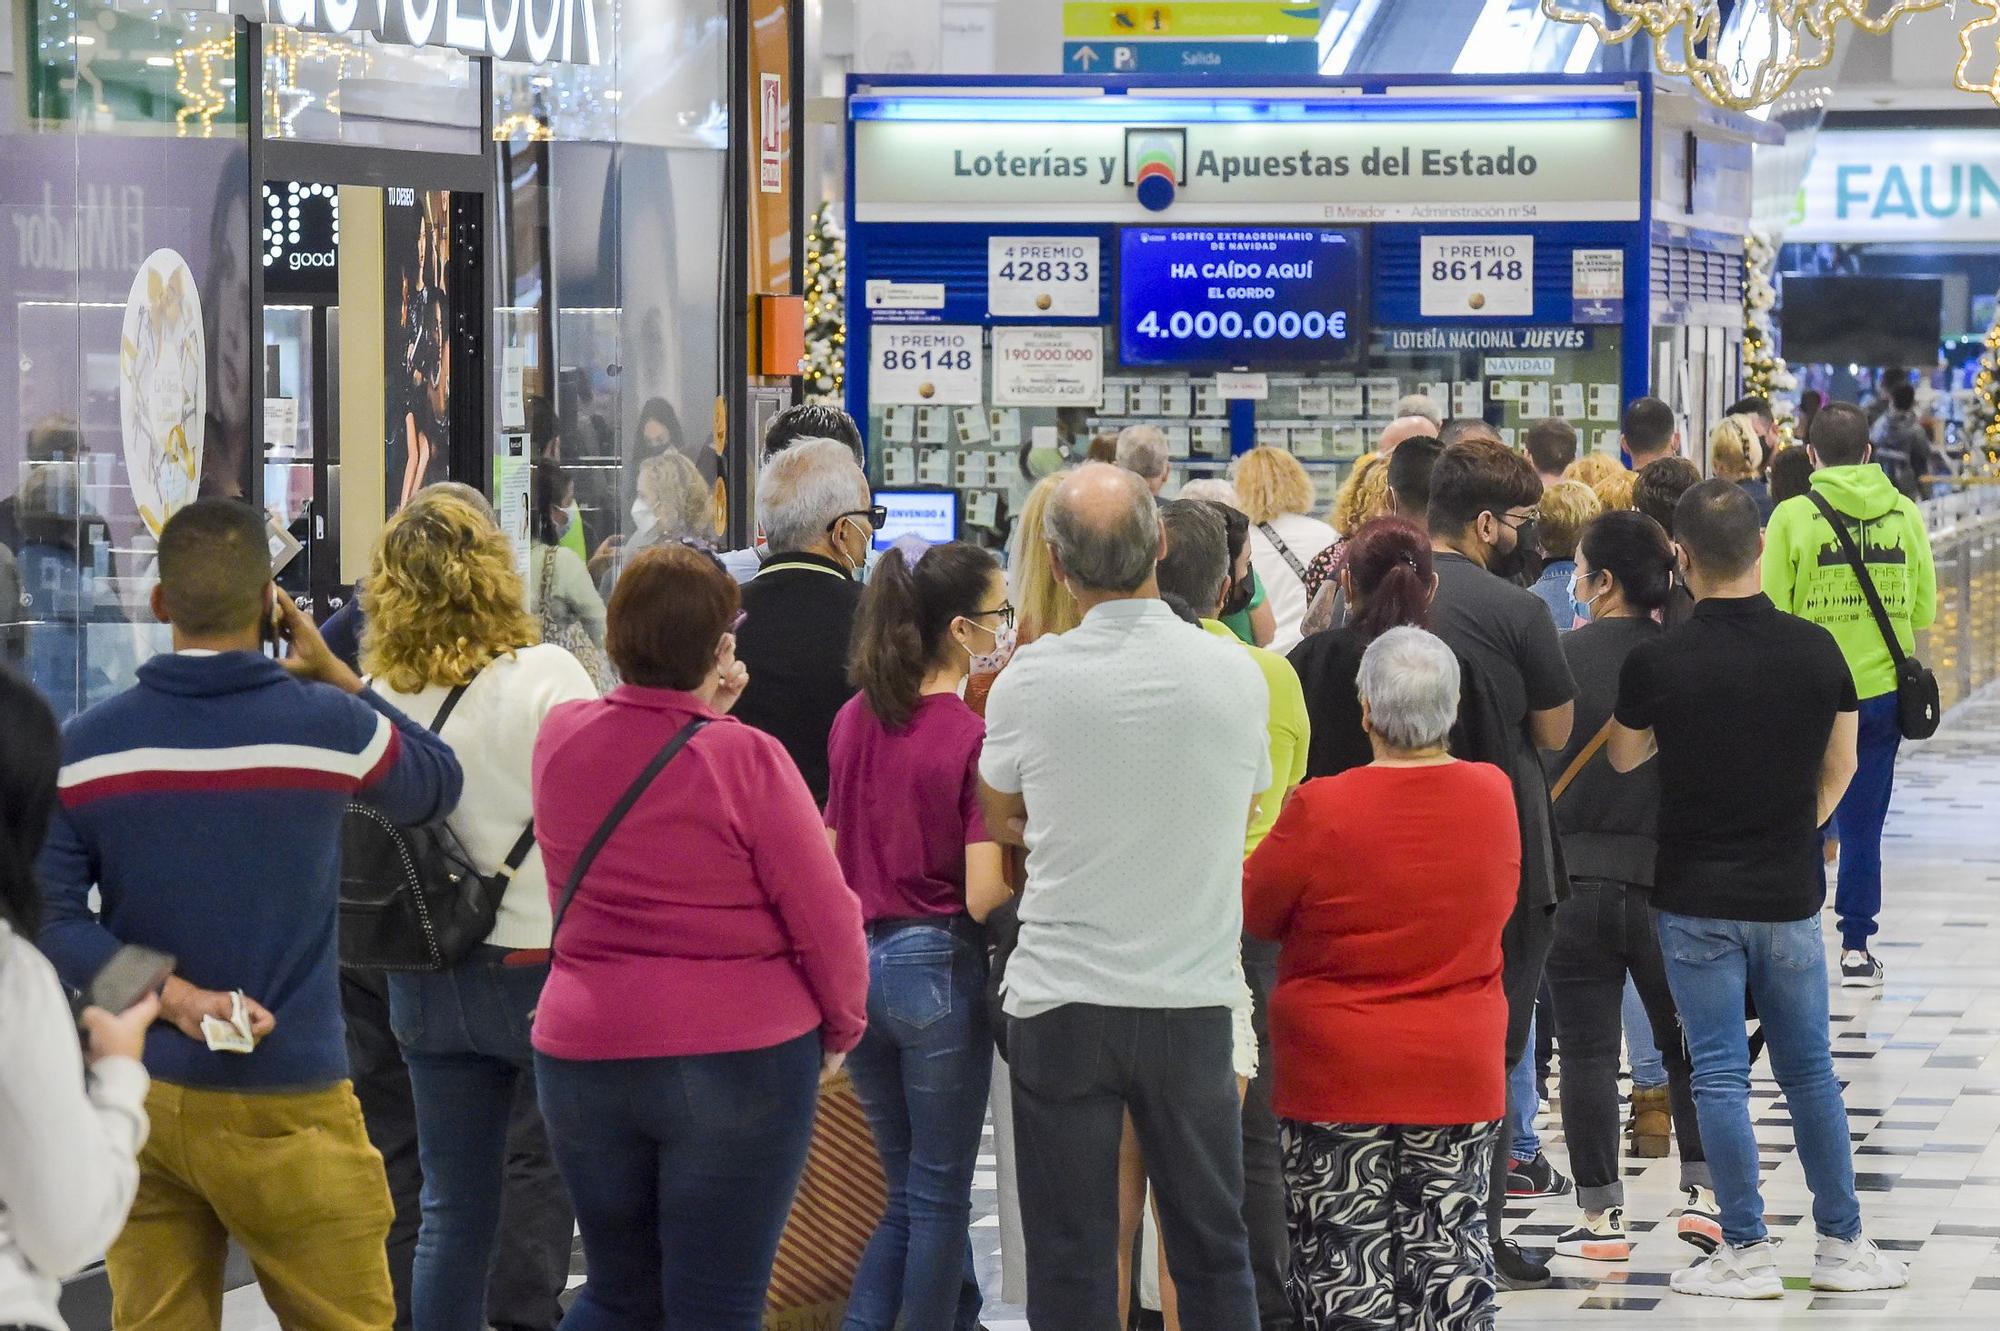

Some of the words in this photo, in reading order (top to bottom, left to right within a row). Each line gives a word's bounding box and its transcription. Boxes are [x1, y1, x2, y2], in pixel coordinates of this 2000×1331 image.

[1182, 52, 1221, 65] Salida
[954, 147, 1088, 176] Loterías
[1100, 155, 1117, 184] y
[1195, 149, 1350, 183] Apuestas
[1361, 146, 1410, 176] del
[1421, 146, 1537, 176] Estado
[396, 187, 414, 207] DESEO
[1324, 206, 1334, 217] El
[1337, 206, 1386, 217] Mirador
[1411, 205, 1505, 217] Administración
[1171, 232, 1214, 241] SORTEO
[1217, 232, 1313, 241] EXTRAORDINARIO
[1021, 246, 1084, 259] PREMIO
[1210, 242, 1225, 251] DE
[1228, 242, 1277, 251] NAVIDAD
[1451, 246, 1515, 258] PREMIO
[289, 249, 335, 270] good
[999, 262, 1089, 281] 42833
[1170, 263, 1198, 279] HA
[1201, 260, 1262, 279] CAÍDO
[1265, 259, 1314, 279] AQUÍ
[1432, 261, 1522, 280] 86148
[1208, 287, 1224, 299] EL
[1226, 287, 1275, 299] GORDO
[1136, 311, 1347, 339] 4.000.000€
[902, 335, 965, 348] PREMIO
[1393, 327, 1446, 349] LOTERÍA
[1449, 330, 1517, 349] NACIONAL
[1521, 329, 1585, 348] JUEVES
[883, 350, 972, 370] 86148
[1487, 359, 1551, 371] NAVIDAD
[1809, 567, 1846, 581] LIFE
[1813, 582, 1835, 594] AT
